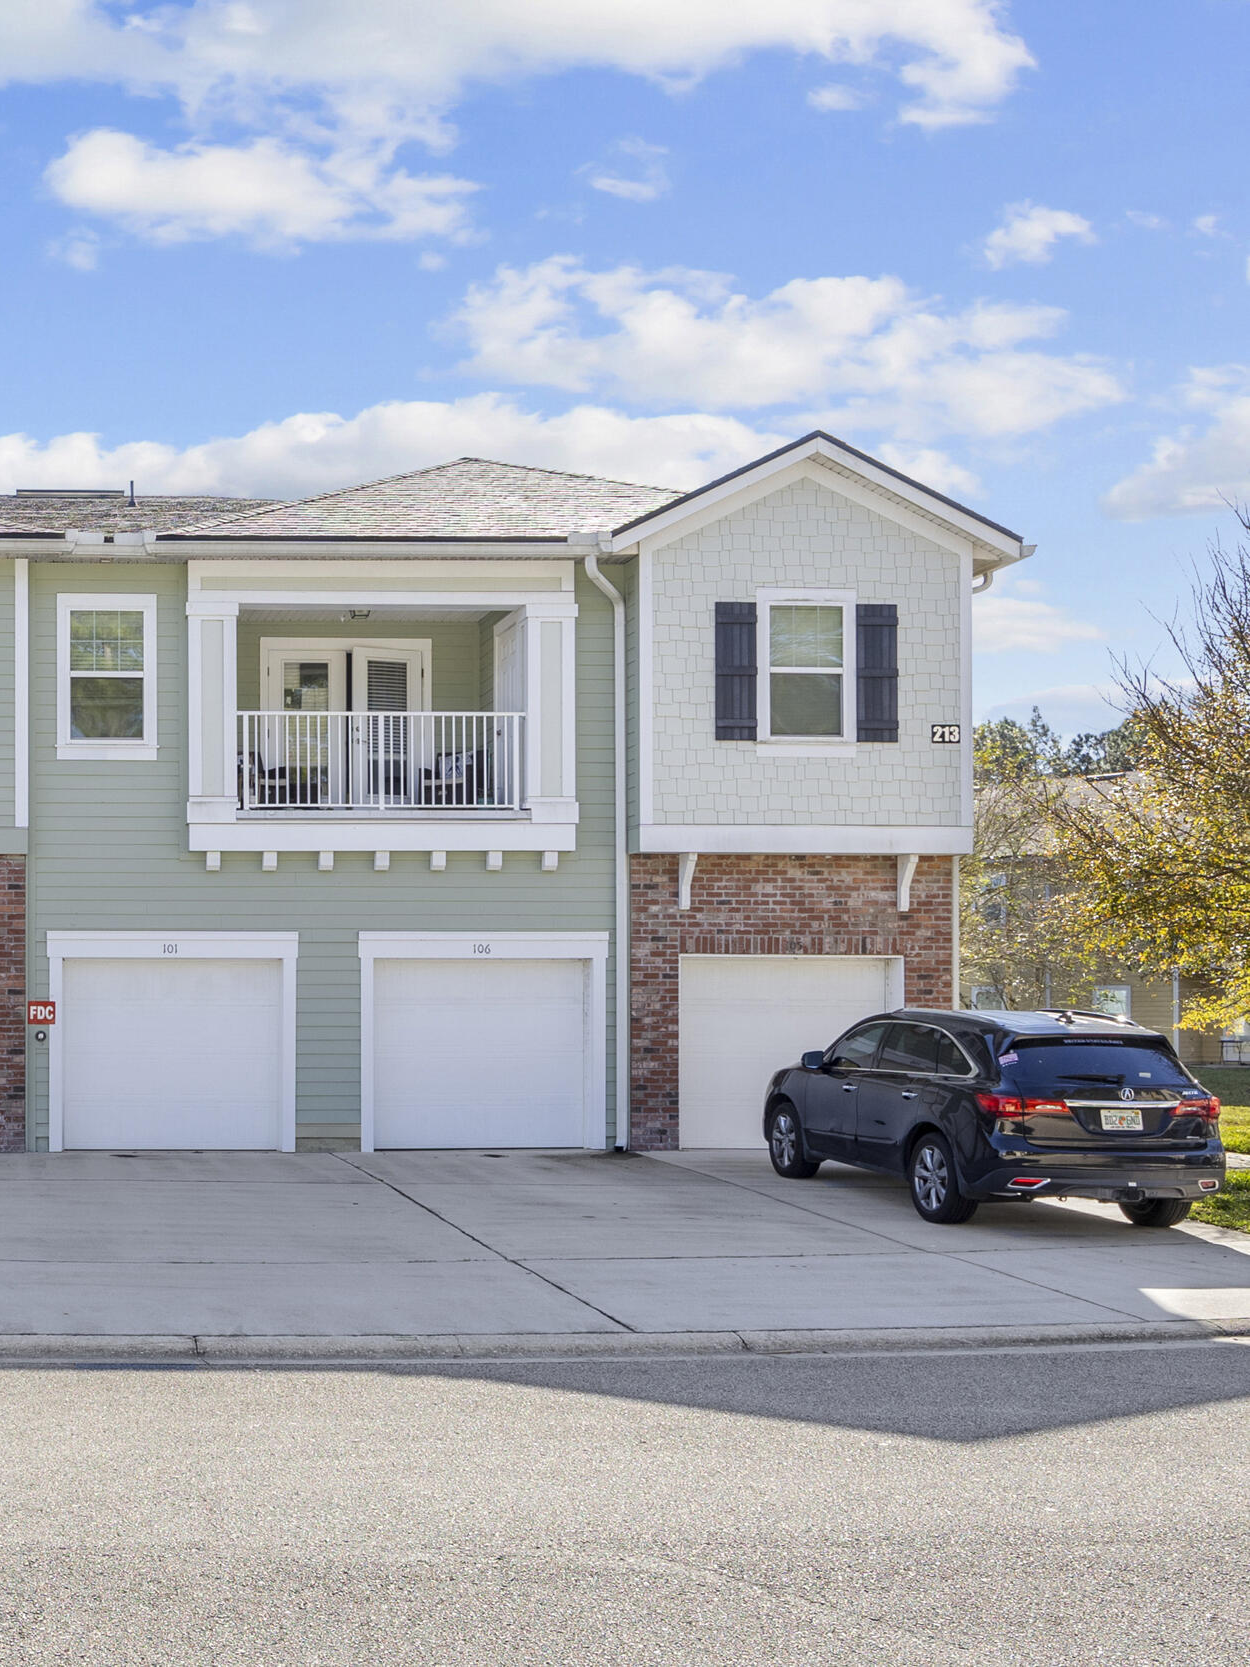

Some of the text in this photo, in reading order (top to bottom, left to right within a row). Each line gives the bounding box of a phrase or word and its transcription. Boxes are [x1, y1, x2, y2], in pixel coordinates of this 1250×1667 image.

[932, 725, 960, 742] 213
[163, 943, 178, 954] 101
[473, 943, 491, 954] 106
[29, 1005, 54, 1020] FDC
